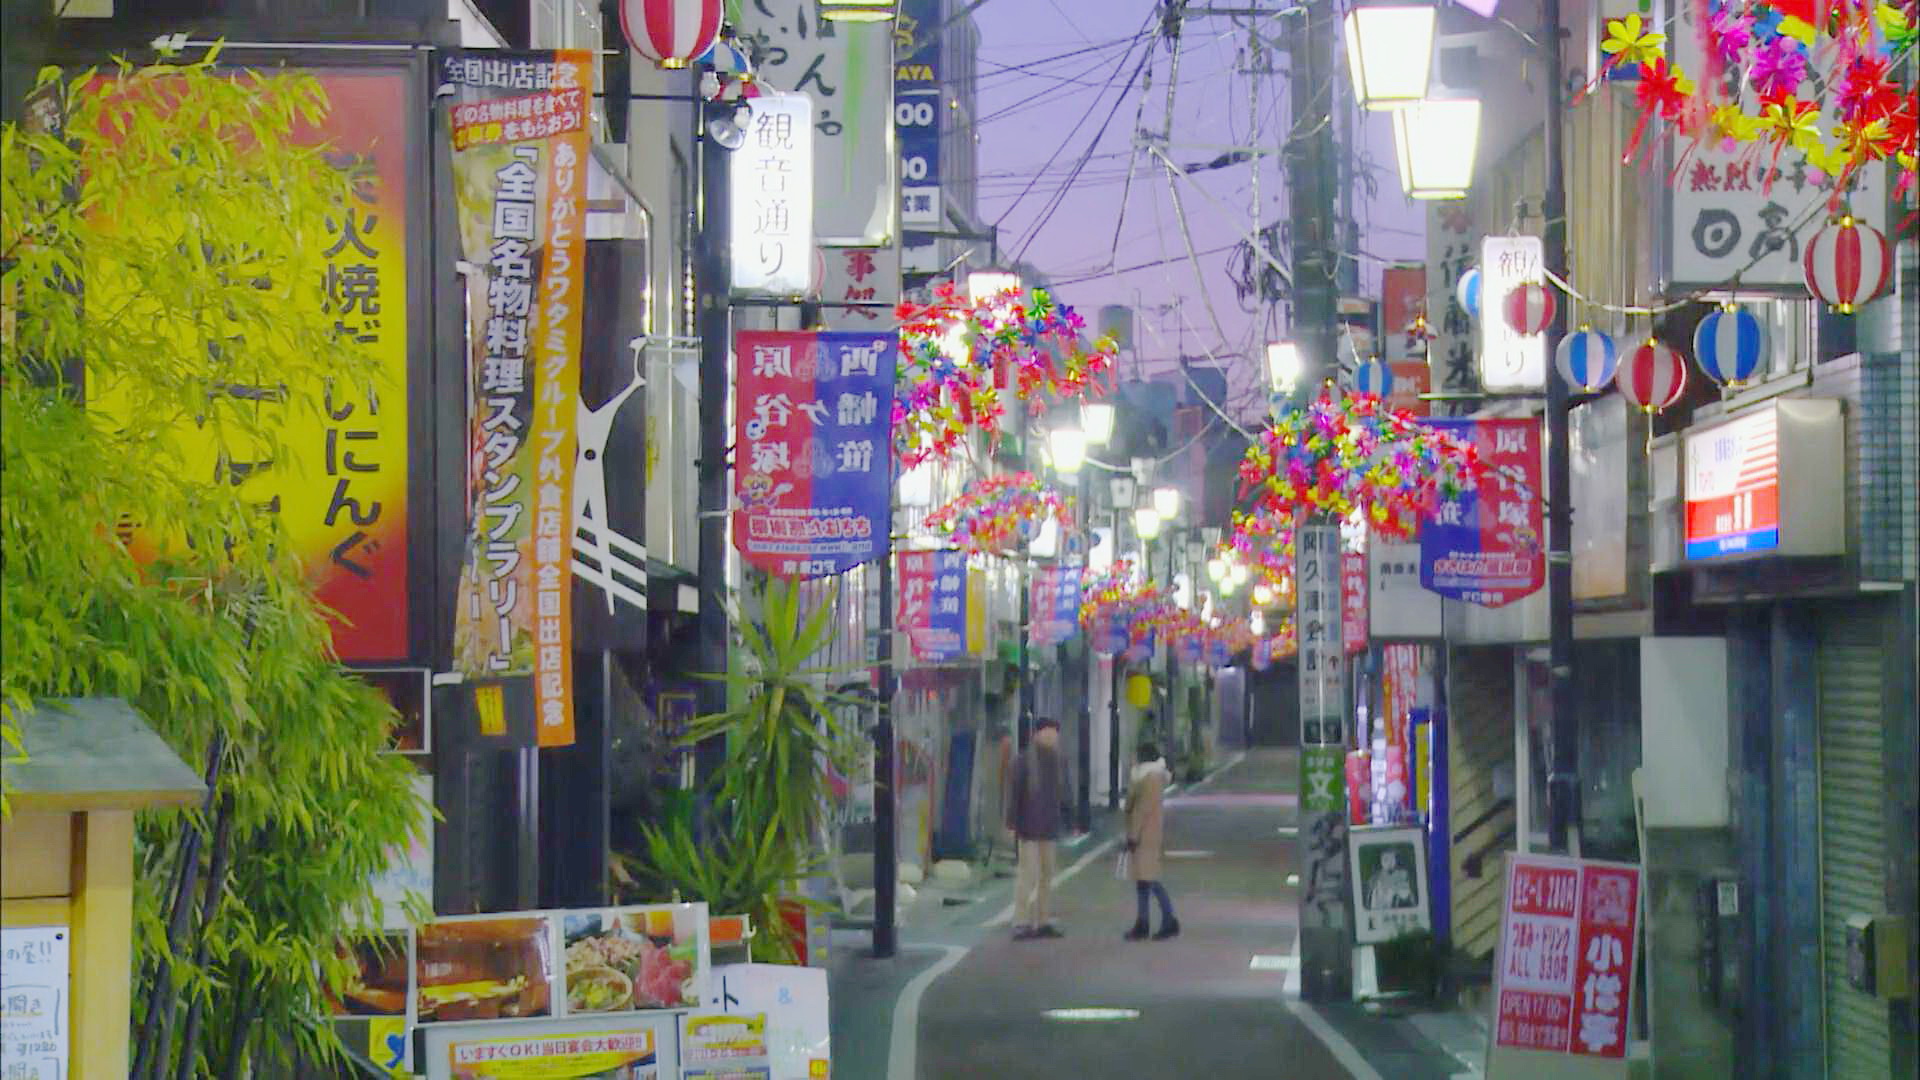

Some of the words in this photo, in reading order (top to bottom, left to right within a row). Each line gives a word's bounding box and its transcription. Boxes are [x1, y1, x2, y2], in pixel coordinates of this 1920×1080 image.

[444, 57, 578, 89] 全国出店記念
[754, 111, 793, 277] 観音通り
[482, 145, 540, 671] 「全国名物料理スタンプラリー」
